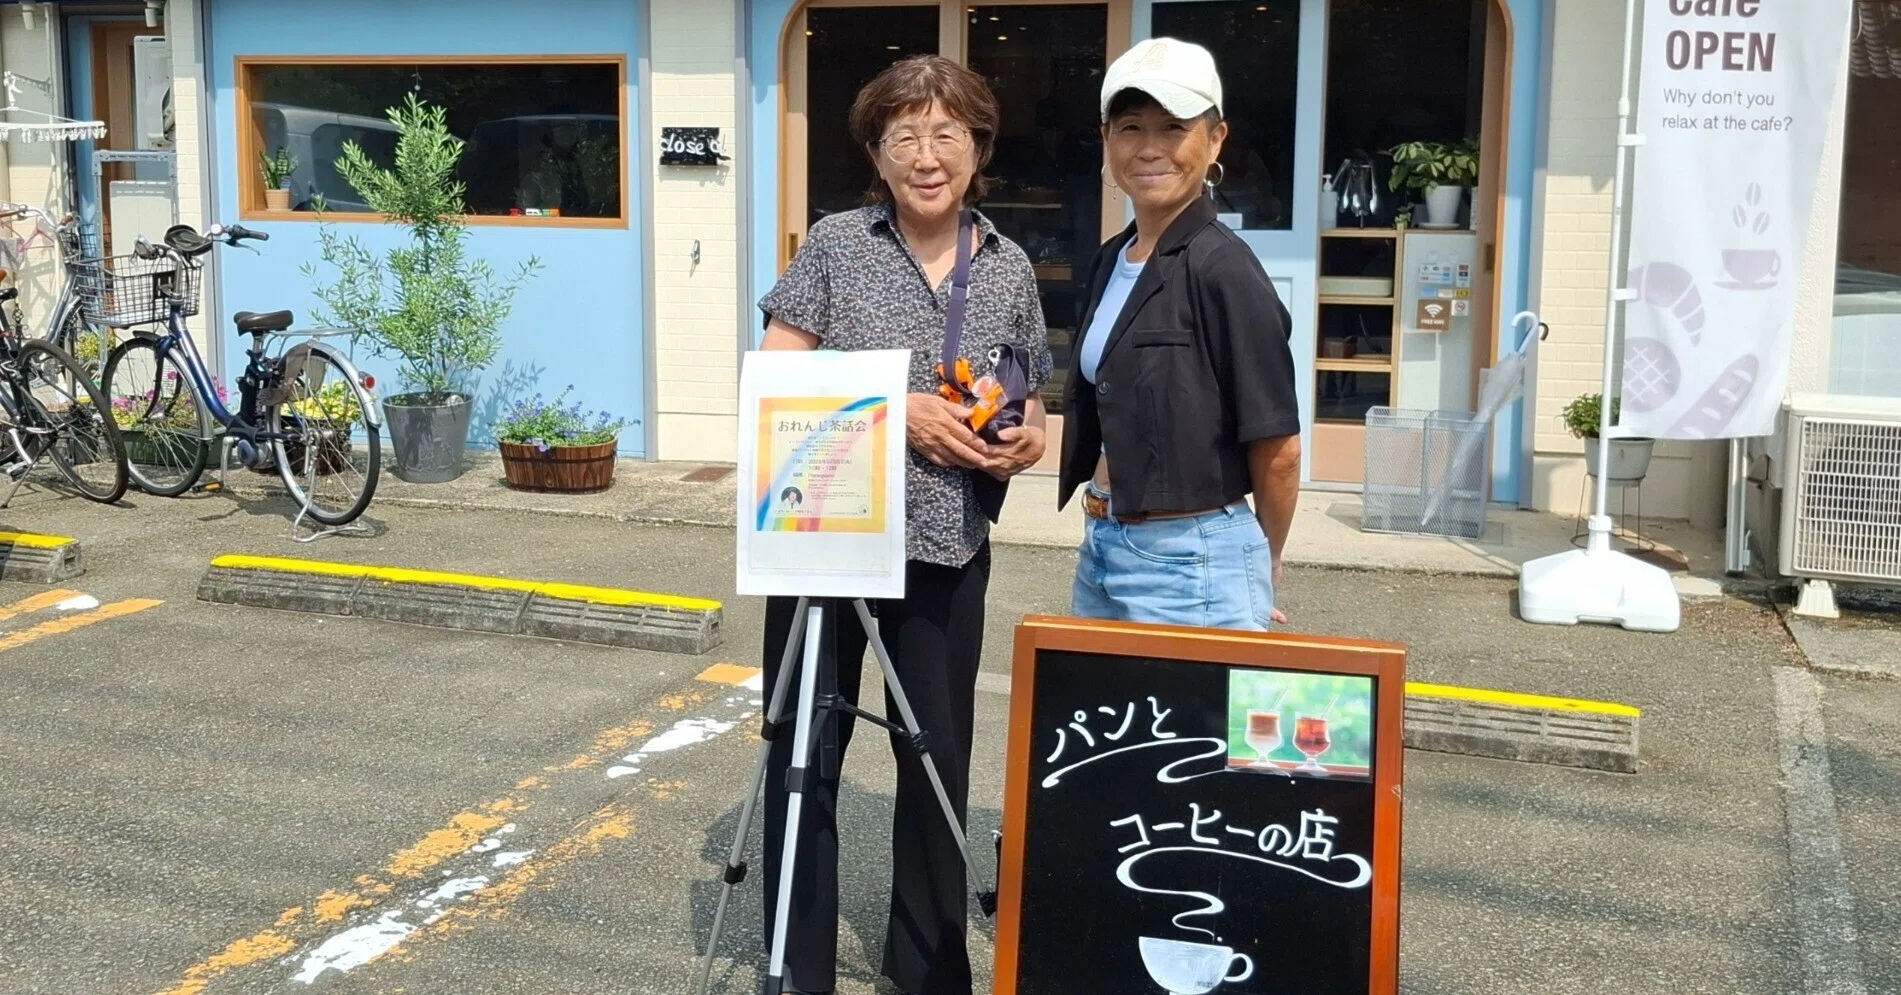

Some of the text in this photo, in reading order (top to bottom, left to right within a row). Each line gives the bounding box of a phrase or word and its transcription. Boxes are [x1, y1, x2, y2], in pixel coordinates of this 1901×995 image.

[1666, 30, 1776, 72] OPEN
[1663, 88, 1775, 109] Why don't you
[1662, 114, 1793, 132] relax at the cafe?
[778, 419, 867, 433] おれんじ茶話会
[1046, 696, 1177, 763] パンと
[1109, 802, 1340, 862] コーヒーの店
